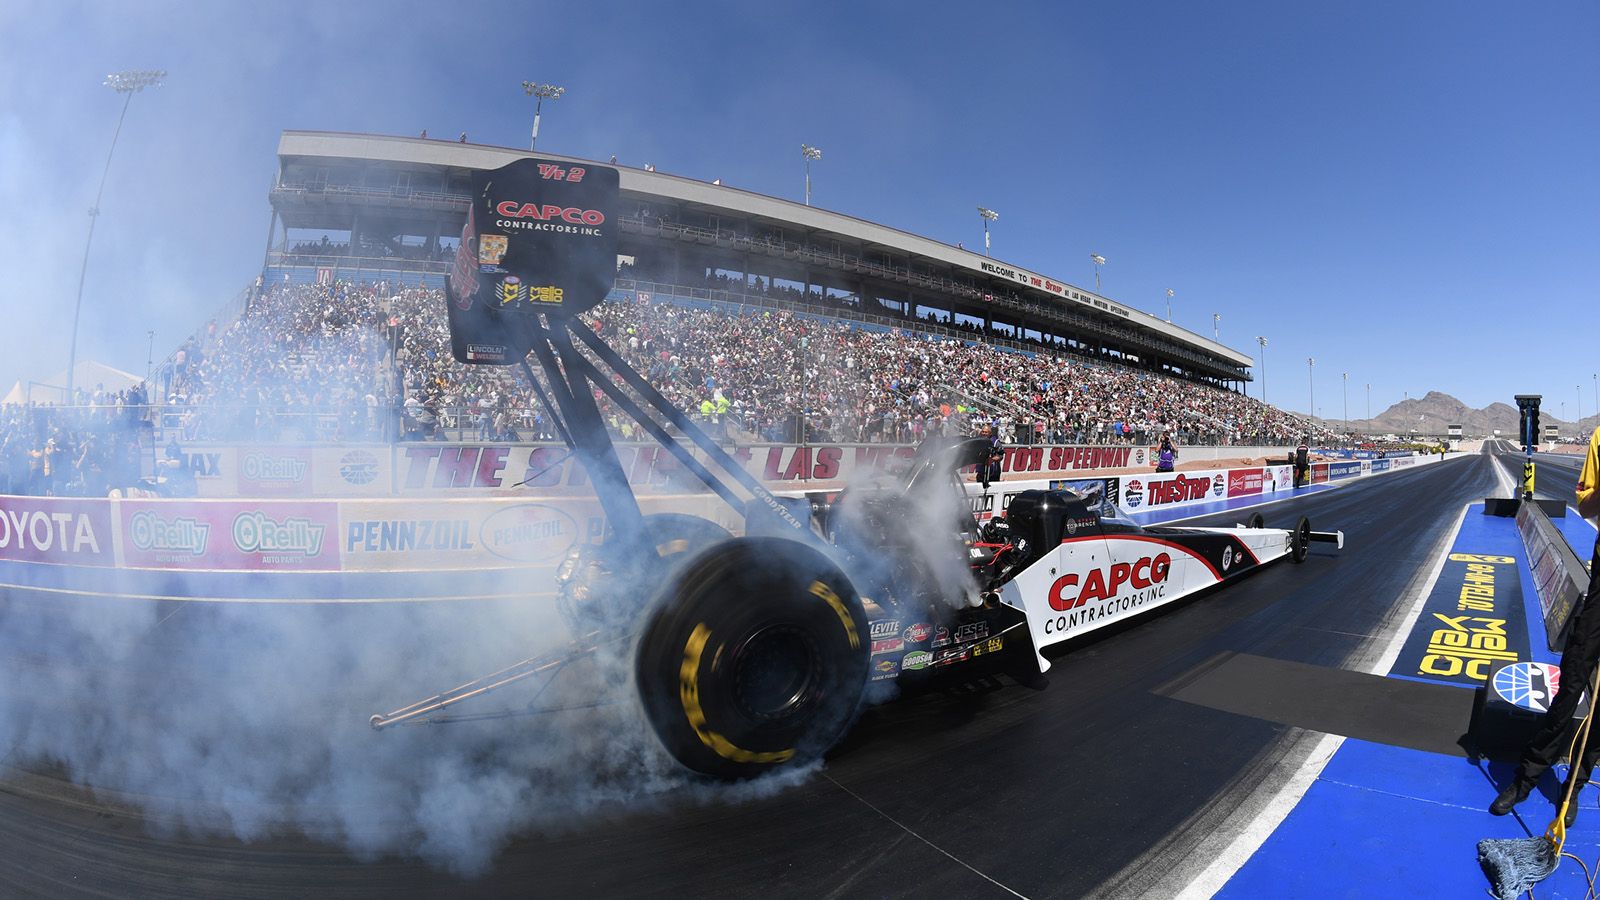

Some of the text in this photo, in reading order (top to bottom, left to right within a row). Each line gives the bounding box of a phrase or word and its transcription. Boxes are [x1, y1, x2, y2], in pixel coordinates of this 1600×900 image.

[566, 167, 586, 183] 2
[496, 201, 605, 226] CAPCO
[496, 219, 603, 237] CONTRACTORS INC.
[980, 261, 1015, 279] WELCOME
[1018, 273, 1028, 283] TO
[1030, 276, 1042, 288] THE
[404, 447, 512, 488] THE
[763, 447, 844, 481] LAS
[1048, 447, 1132, 471] SPEEDWAY
[752, 486, 803, 530] GOODYEAR
[130, 511, 209, 555] O'Reilly
[232, 510, 325, 556] O'Reilly
[346, 520, 474, 552] PENNZOIL
[493, 518, 564, 546] PENNZOIL
[262, 556, 279, 564] AUTO
[1047, 552, 1171, 612] CAPCO
[870, 620, 900, 635] LEVITE
[1044, 594, 1143, 635] CONTRACTORS
[954, 621, 990, 641] JESEL
[902, 653, 934, 668] GOODSON
